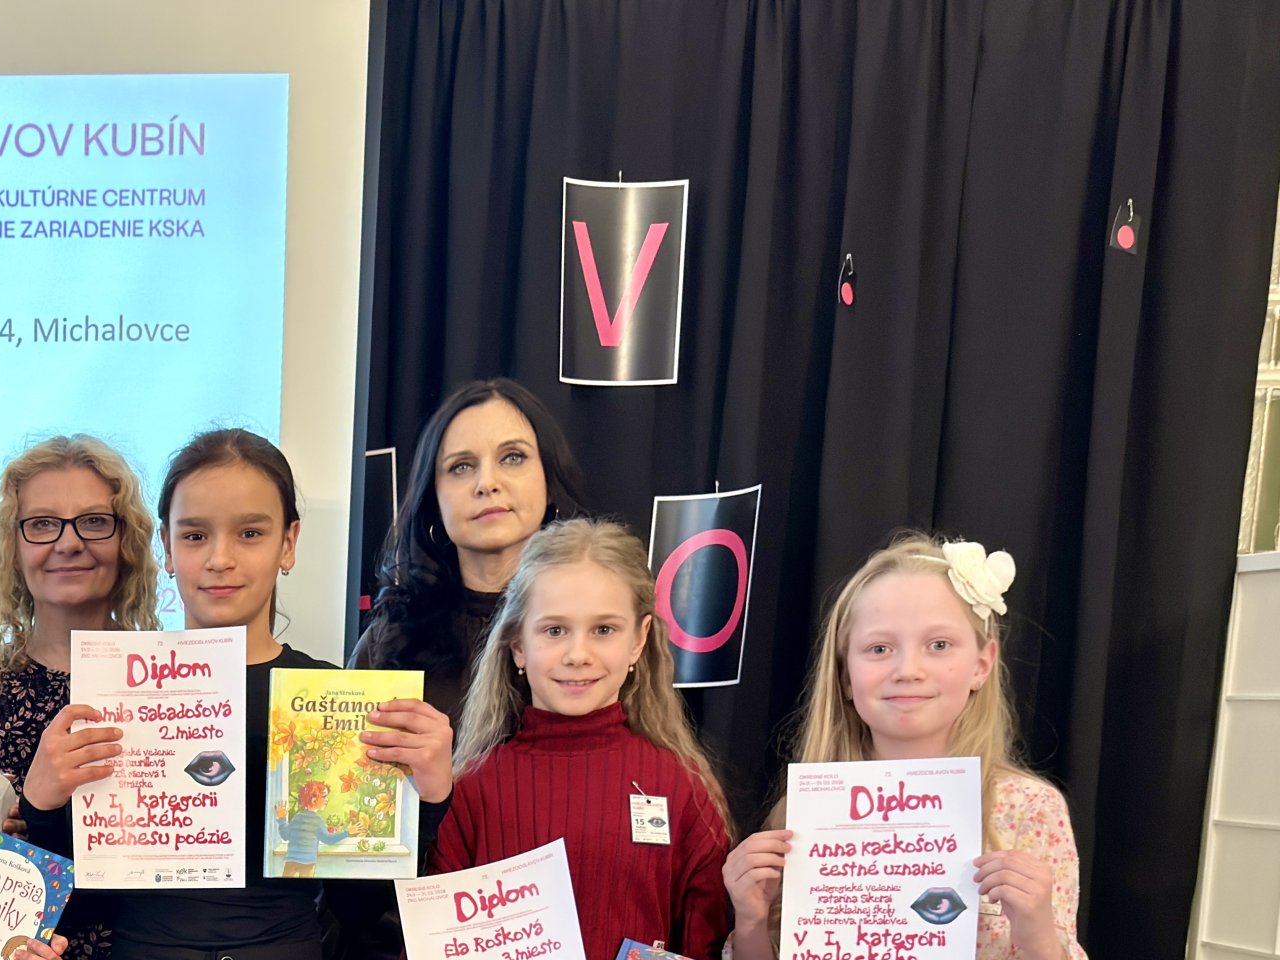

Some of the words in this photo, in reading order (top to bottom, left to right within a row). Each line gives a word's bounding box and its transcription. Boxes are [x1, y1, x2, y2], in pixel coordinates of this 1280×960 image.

[85, 115, 206, 156] KUBÍN
[103, 188, 206, 207] CENTRUM
[20, 220, 143, 239] ZARIADENIE
[149, 219, 205, 238] KSKA
[572, 219, 669, 348] V
[33, 315, 191, 343] Michalovce
[654, 528, 749, 653] O
[127, 650, 211, 689] Diplom
[138, 699, 233, 723] Sabadošová
[291, 695, 396, 714] Gaštano
[322, 714, 368, 731] Emil
[137, 787, 218, 812] kategórii
[850, 781, 942, 822] Diplom
[82, 803, 193, 828] umeleckého
[88, 829, 170, 851] prednesu
[175, 827, 232, 851] poézie
[809, 843, 857, 858] Anna
[861, 833, 958, 857] Kačkošová
[819, 860, 879, 877] čestné
[883, 861, 946, 877] uznanie
[0, 876, 43, 905] pršia
[454, 879, 540, 923] Diplom
[444, 937, 470, 959] Ela
[473, 918, 544, 953] Rošková
[793, 930, 808, 946] V
[856, 924, 946, 951] kategórii
